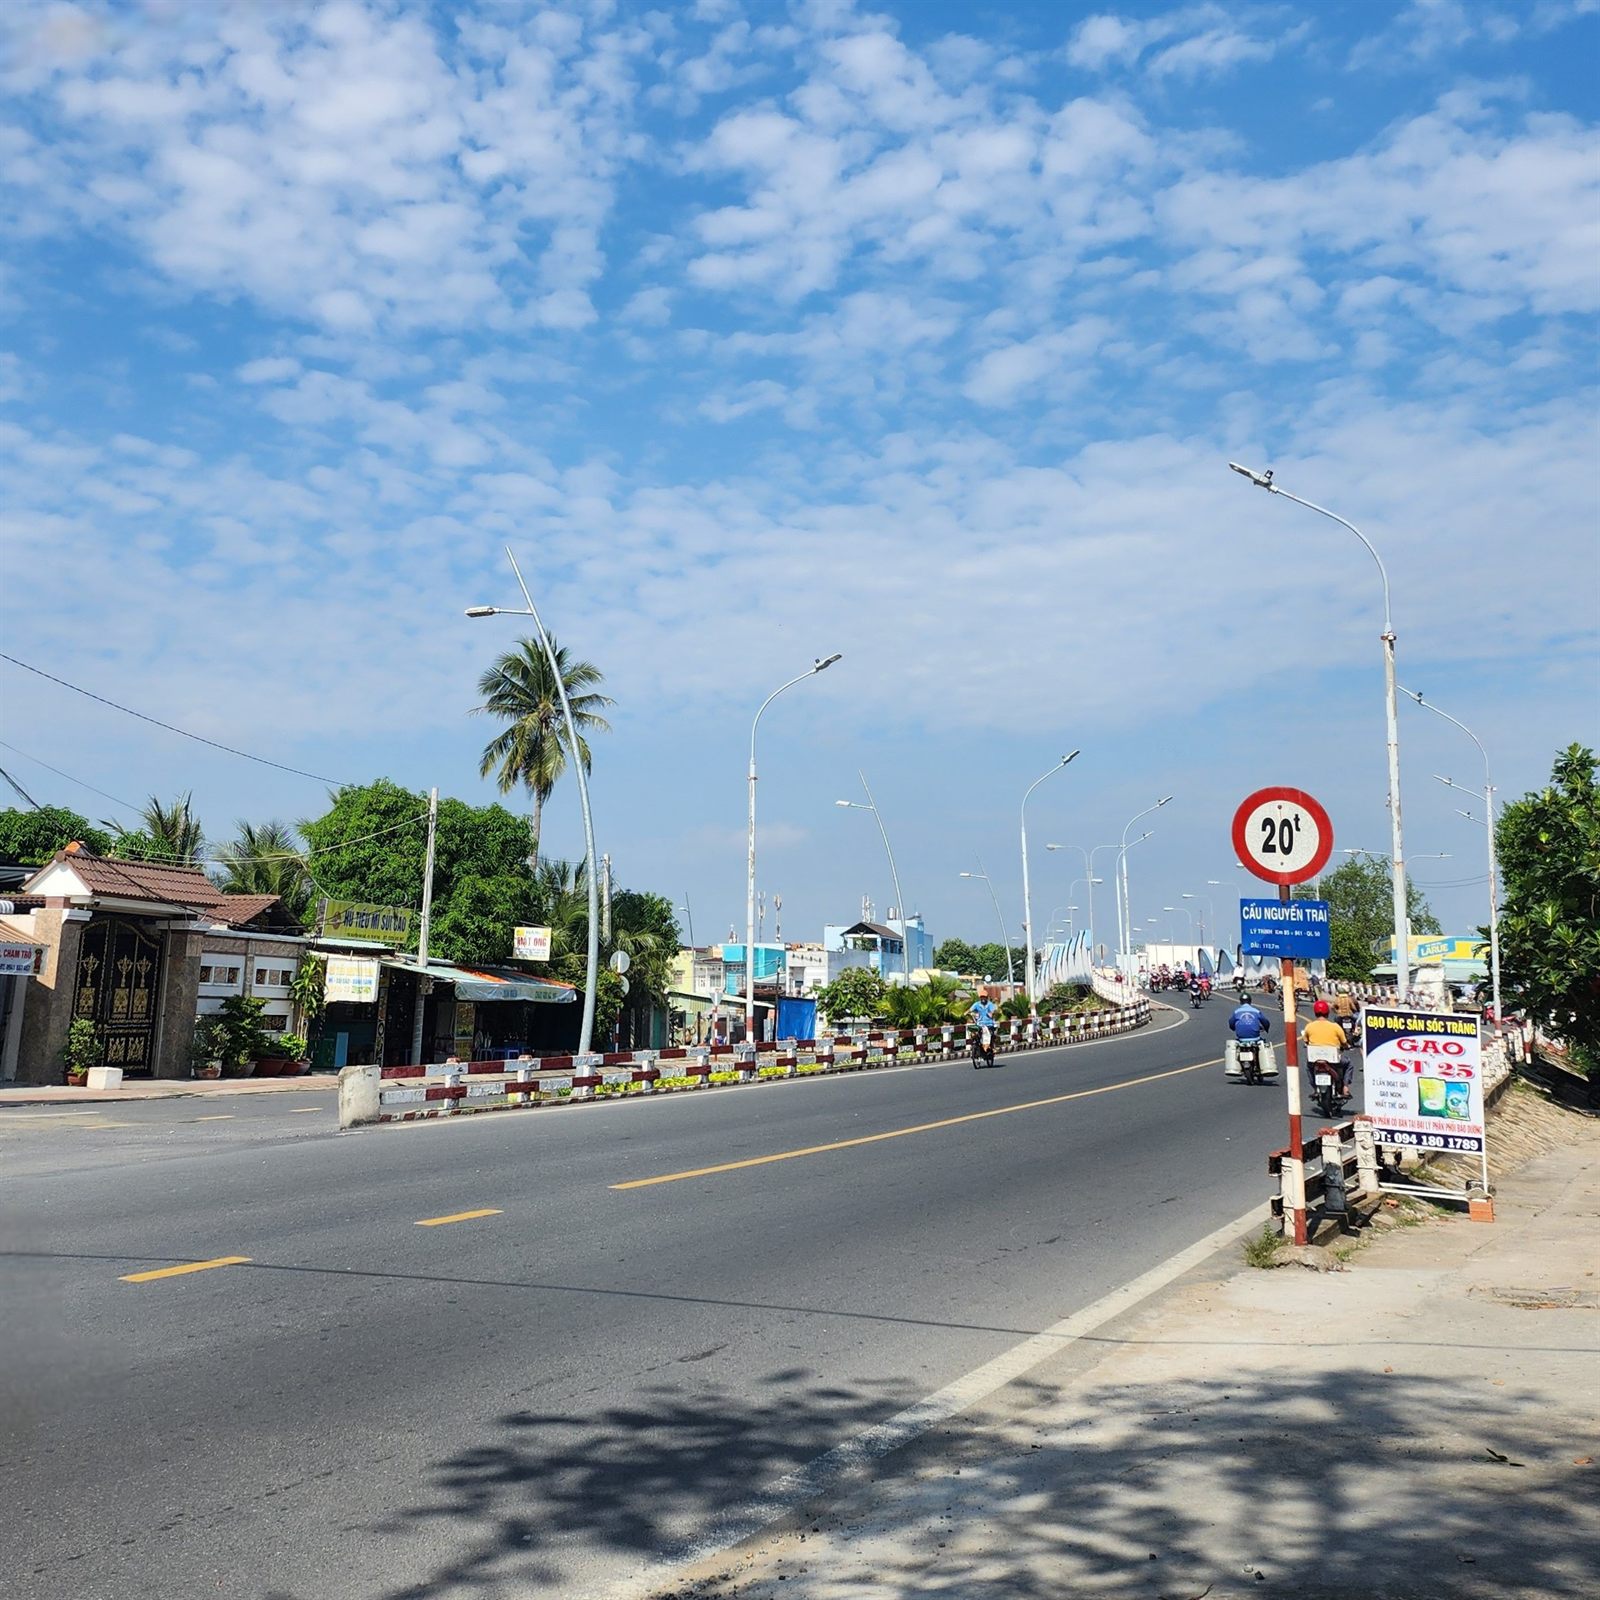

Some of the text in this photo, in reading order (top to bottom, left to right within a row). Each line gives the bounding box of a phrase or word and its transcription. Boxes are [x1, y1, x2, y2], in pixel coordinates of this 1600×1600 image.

[1242, 903, 1327, 923] CẦU NGUYỄN TRÃI
[1420, 943, 1449, 956] LARUE
[1367, 1015, 1385, 1030] GẠO
[1386, 1015, 1405, 1032] ĐẶC
[1406, 1015, 1425, 1032] SẢN
[1426, 1017, 1445, 1033] SÓC
[1446, 1020, 1476, 1035] TRĂNG
[1396, 1038, 1466, 1058] GẠO
[1389, 1058, 1475, 1079] ST 25
[1394, 1132, 1418, 1145] 094
[1421, 1135, 1444, 1147] 180
[1447, 1138, 1478, 1150] 1789
